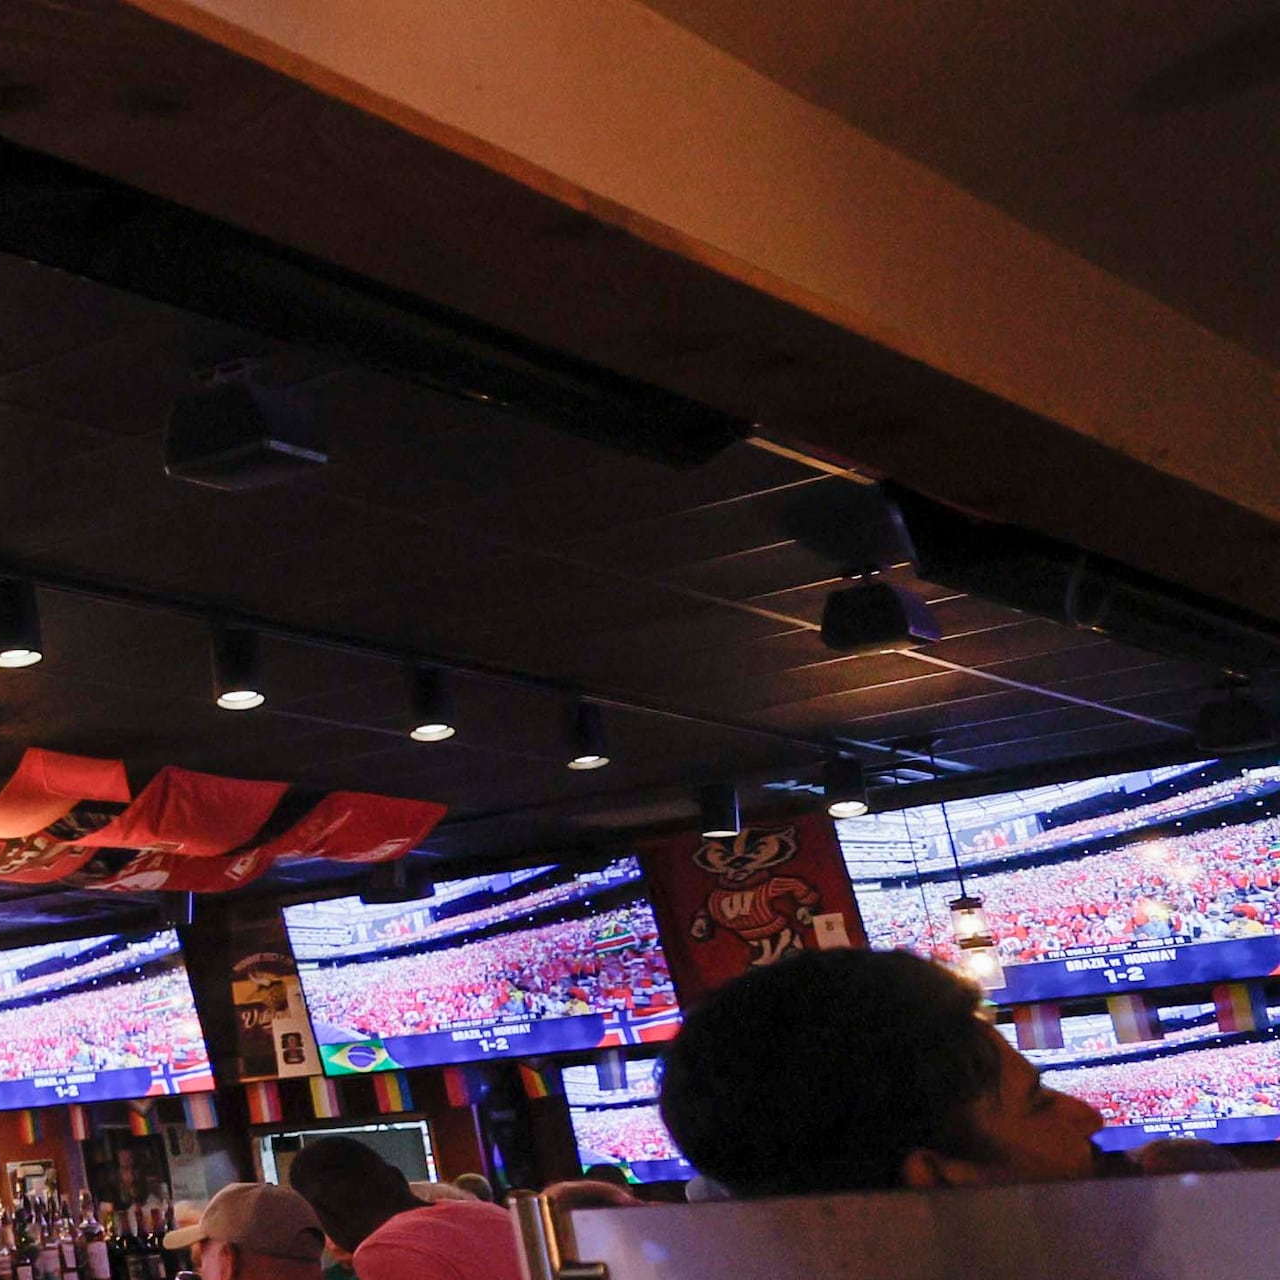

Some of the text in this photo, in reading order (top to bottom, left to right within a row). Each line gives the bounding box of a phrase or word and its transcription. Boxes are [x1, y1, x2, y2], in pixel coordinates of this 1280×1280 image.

[1066, 957, 1109, 972] BRAZIL
[1124, 949, 1177, 966] NORWAY
[1103, 966, 1146, 984] 1-2
[452, 1029, 483, 1041] BRAZIL
[479, 1037, 509, 1052] 1-2
